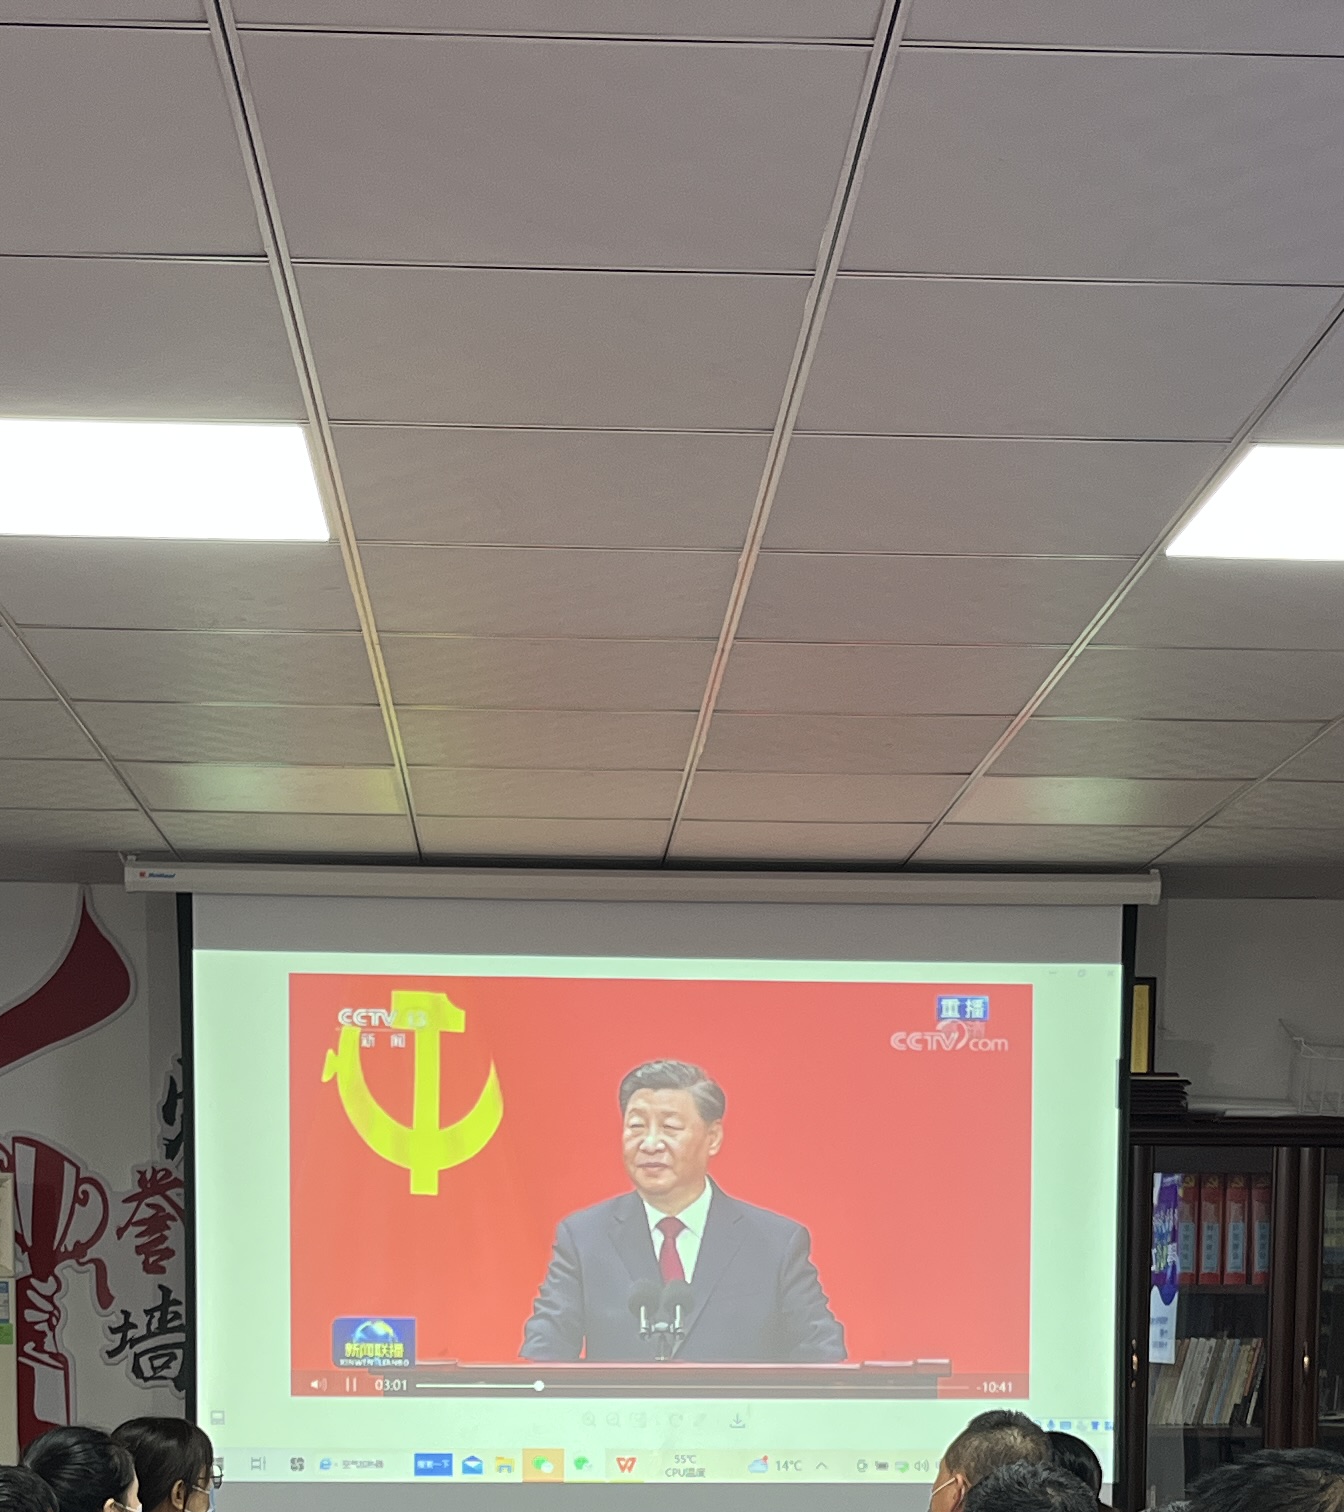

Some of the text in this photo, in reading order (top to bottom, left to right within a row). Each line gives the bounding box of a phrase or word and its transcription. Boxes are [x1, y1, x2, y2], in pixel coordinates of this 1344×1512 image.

[941, 998, 985, 1018] 重播
[338, 1008, 397, 1027] CCTV
[345, 1343, 404, 1358] 新闻联播
[375, 1379, 408, 1391] 03:01
